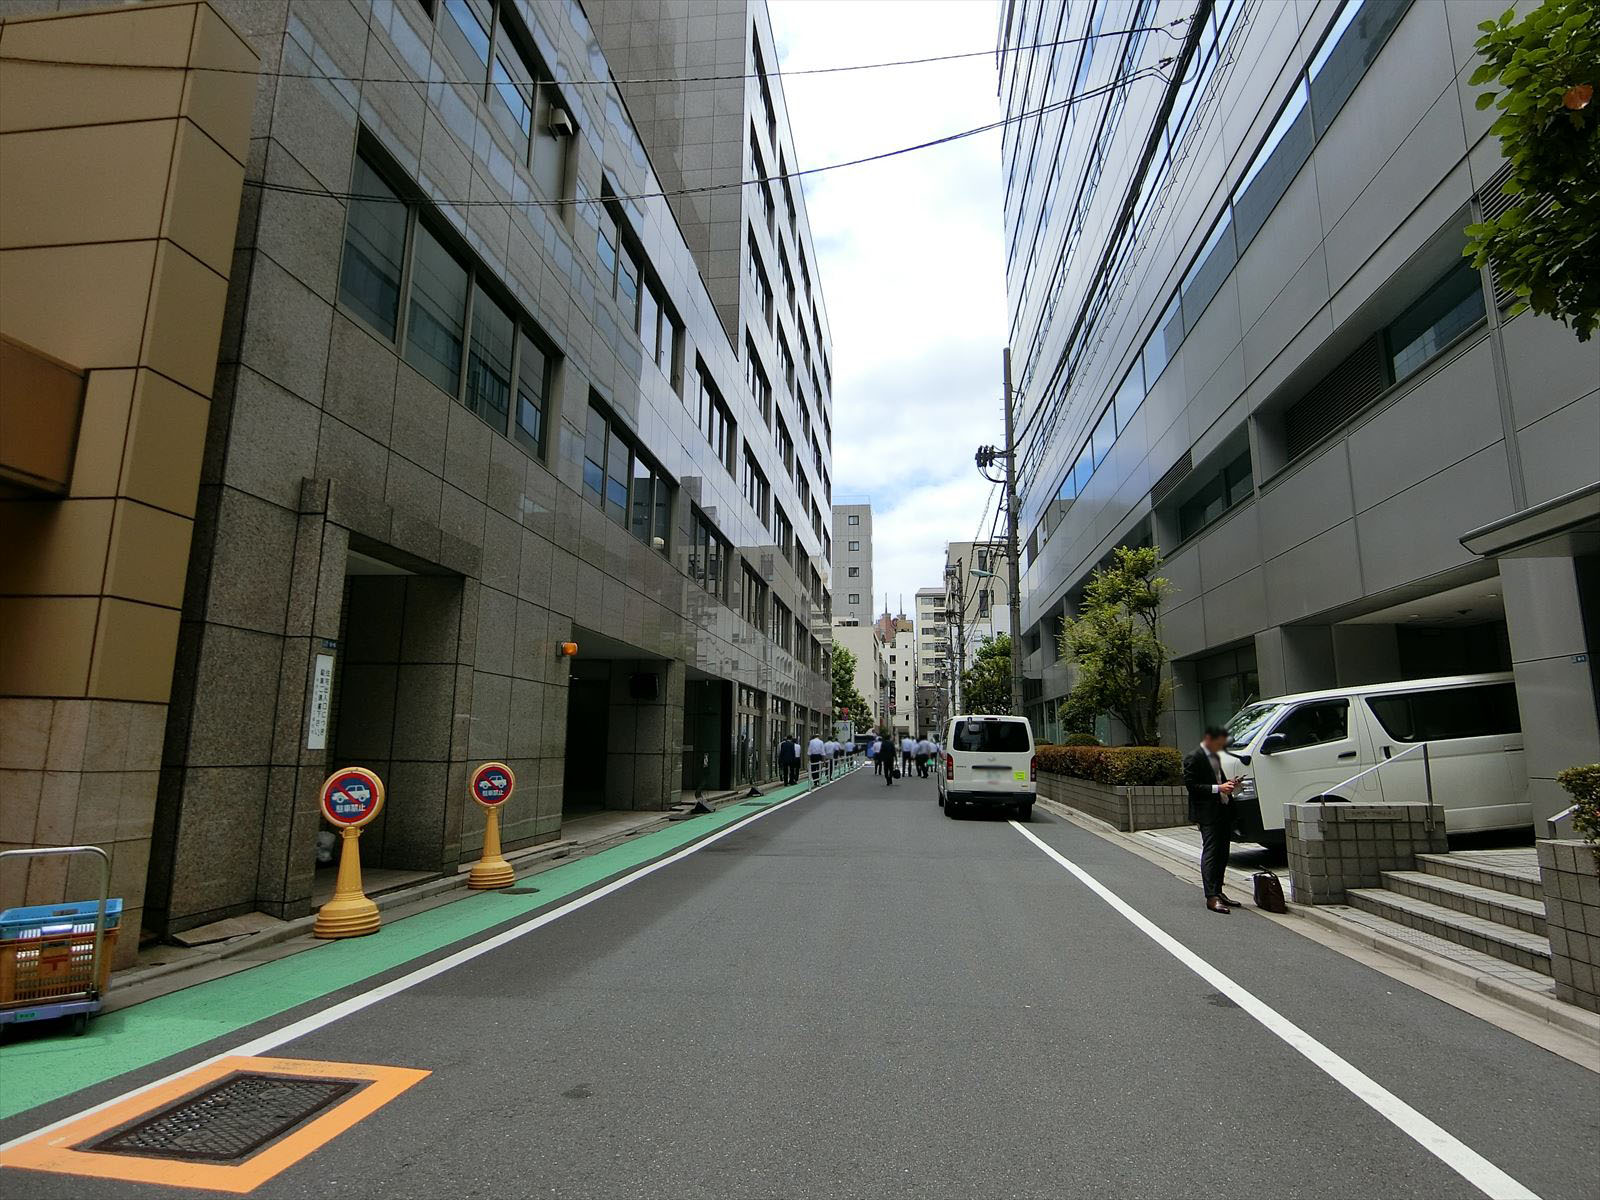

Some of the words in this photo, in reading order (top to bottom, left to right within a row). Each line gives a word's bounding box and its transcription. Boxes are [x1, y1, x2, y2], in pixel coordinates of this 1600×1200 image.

[482, 789, 504, 797] 駐車禁止
[335, 803, 366, 813] 駐車禁止
